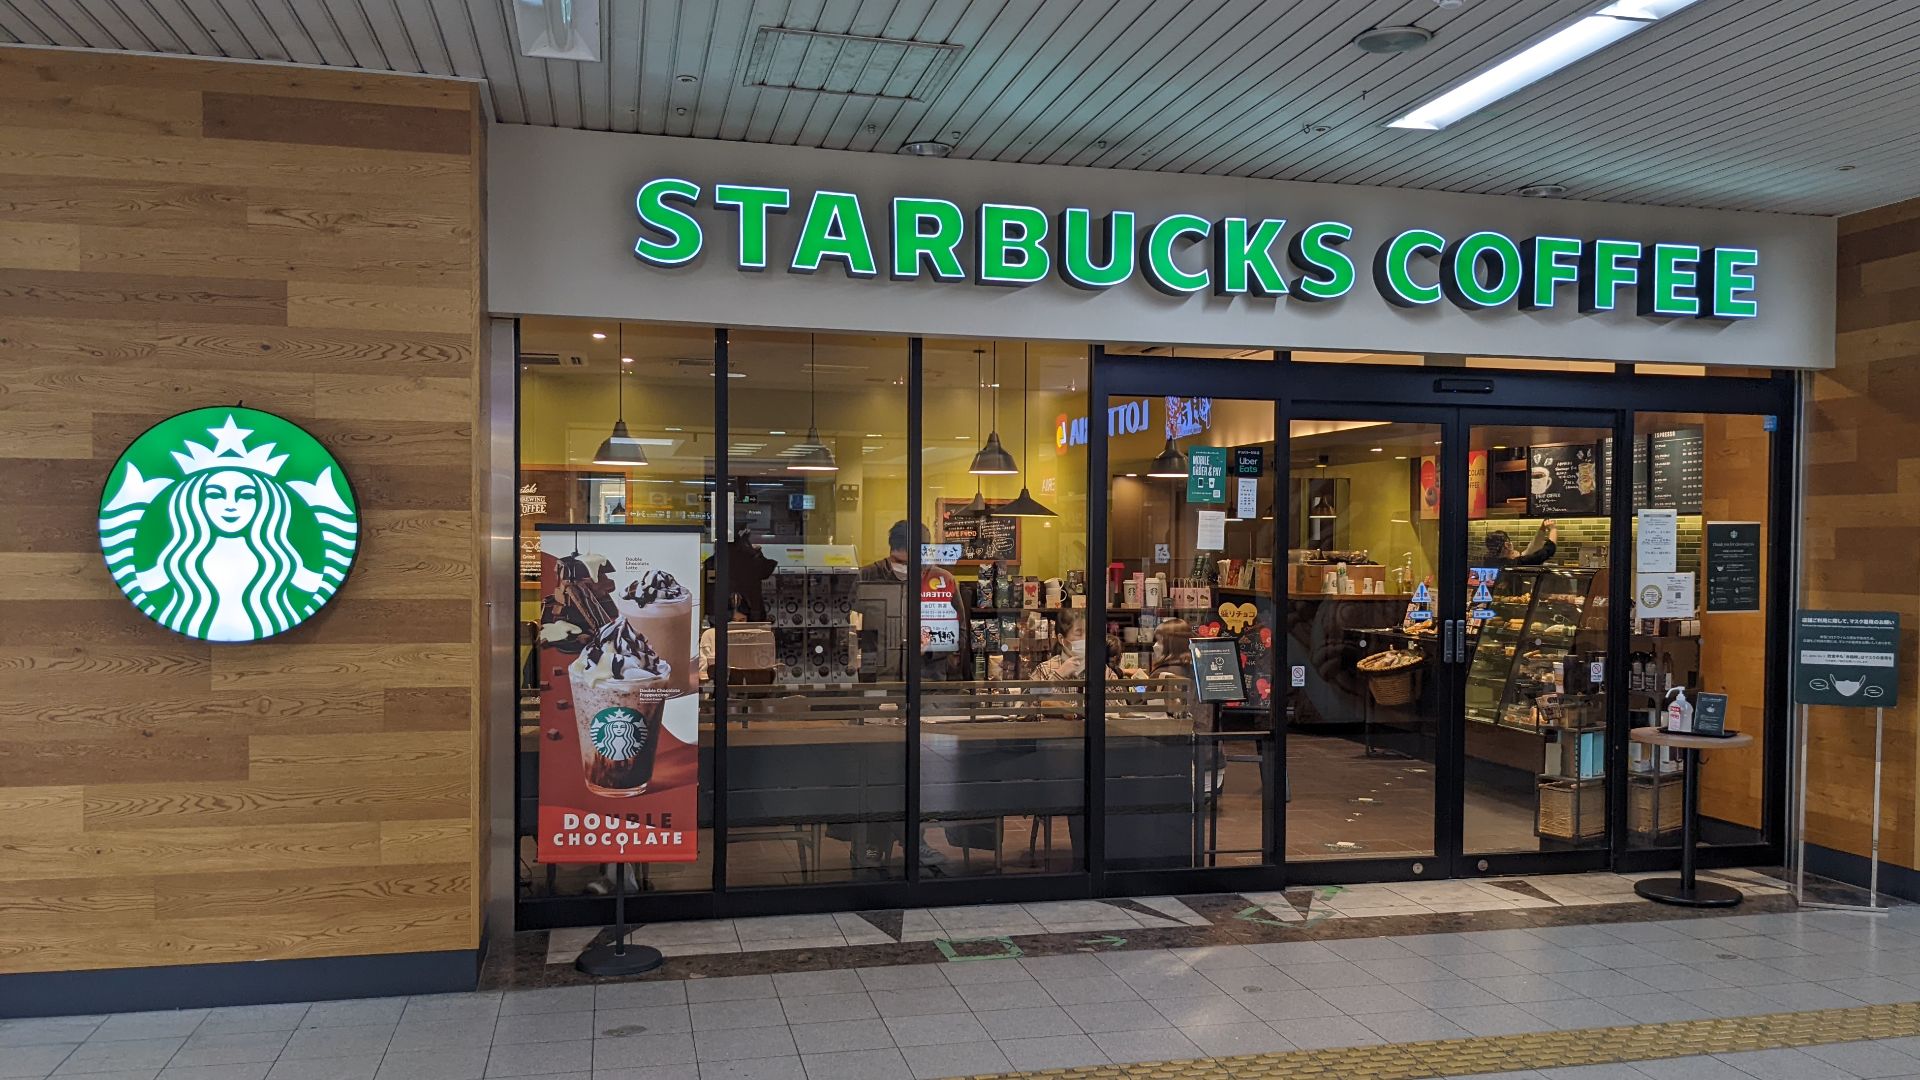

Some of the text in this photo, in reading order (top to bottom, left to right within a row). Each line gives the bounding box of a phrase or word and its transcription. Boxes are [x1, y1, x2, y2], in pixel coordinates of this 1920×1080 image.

[634, 178, 1759, 317] STARBUCKS COFFEE
[1192, 455, 1210, 465] MOBILE
[1239, 457, 1258, 465] Uber
[1220, 609, 1256, 618] 盛りチョコ
[563, 813, 672, 830] DOUBLE
[553, 832, 682, 851] CHOCOLATE
